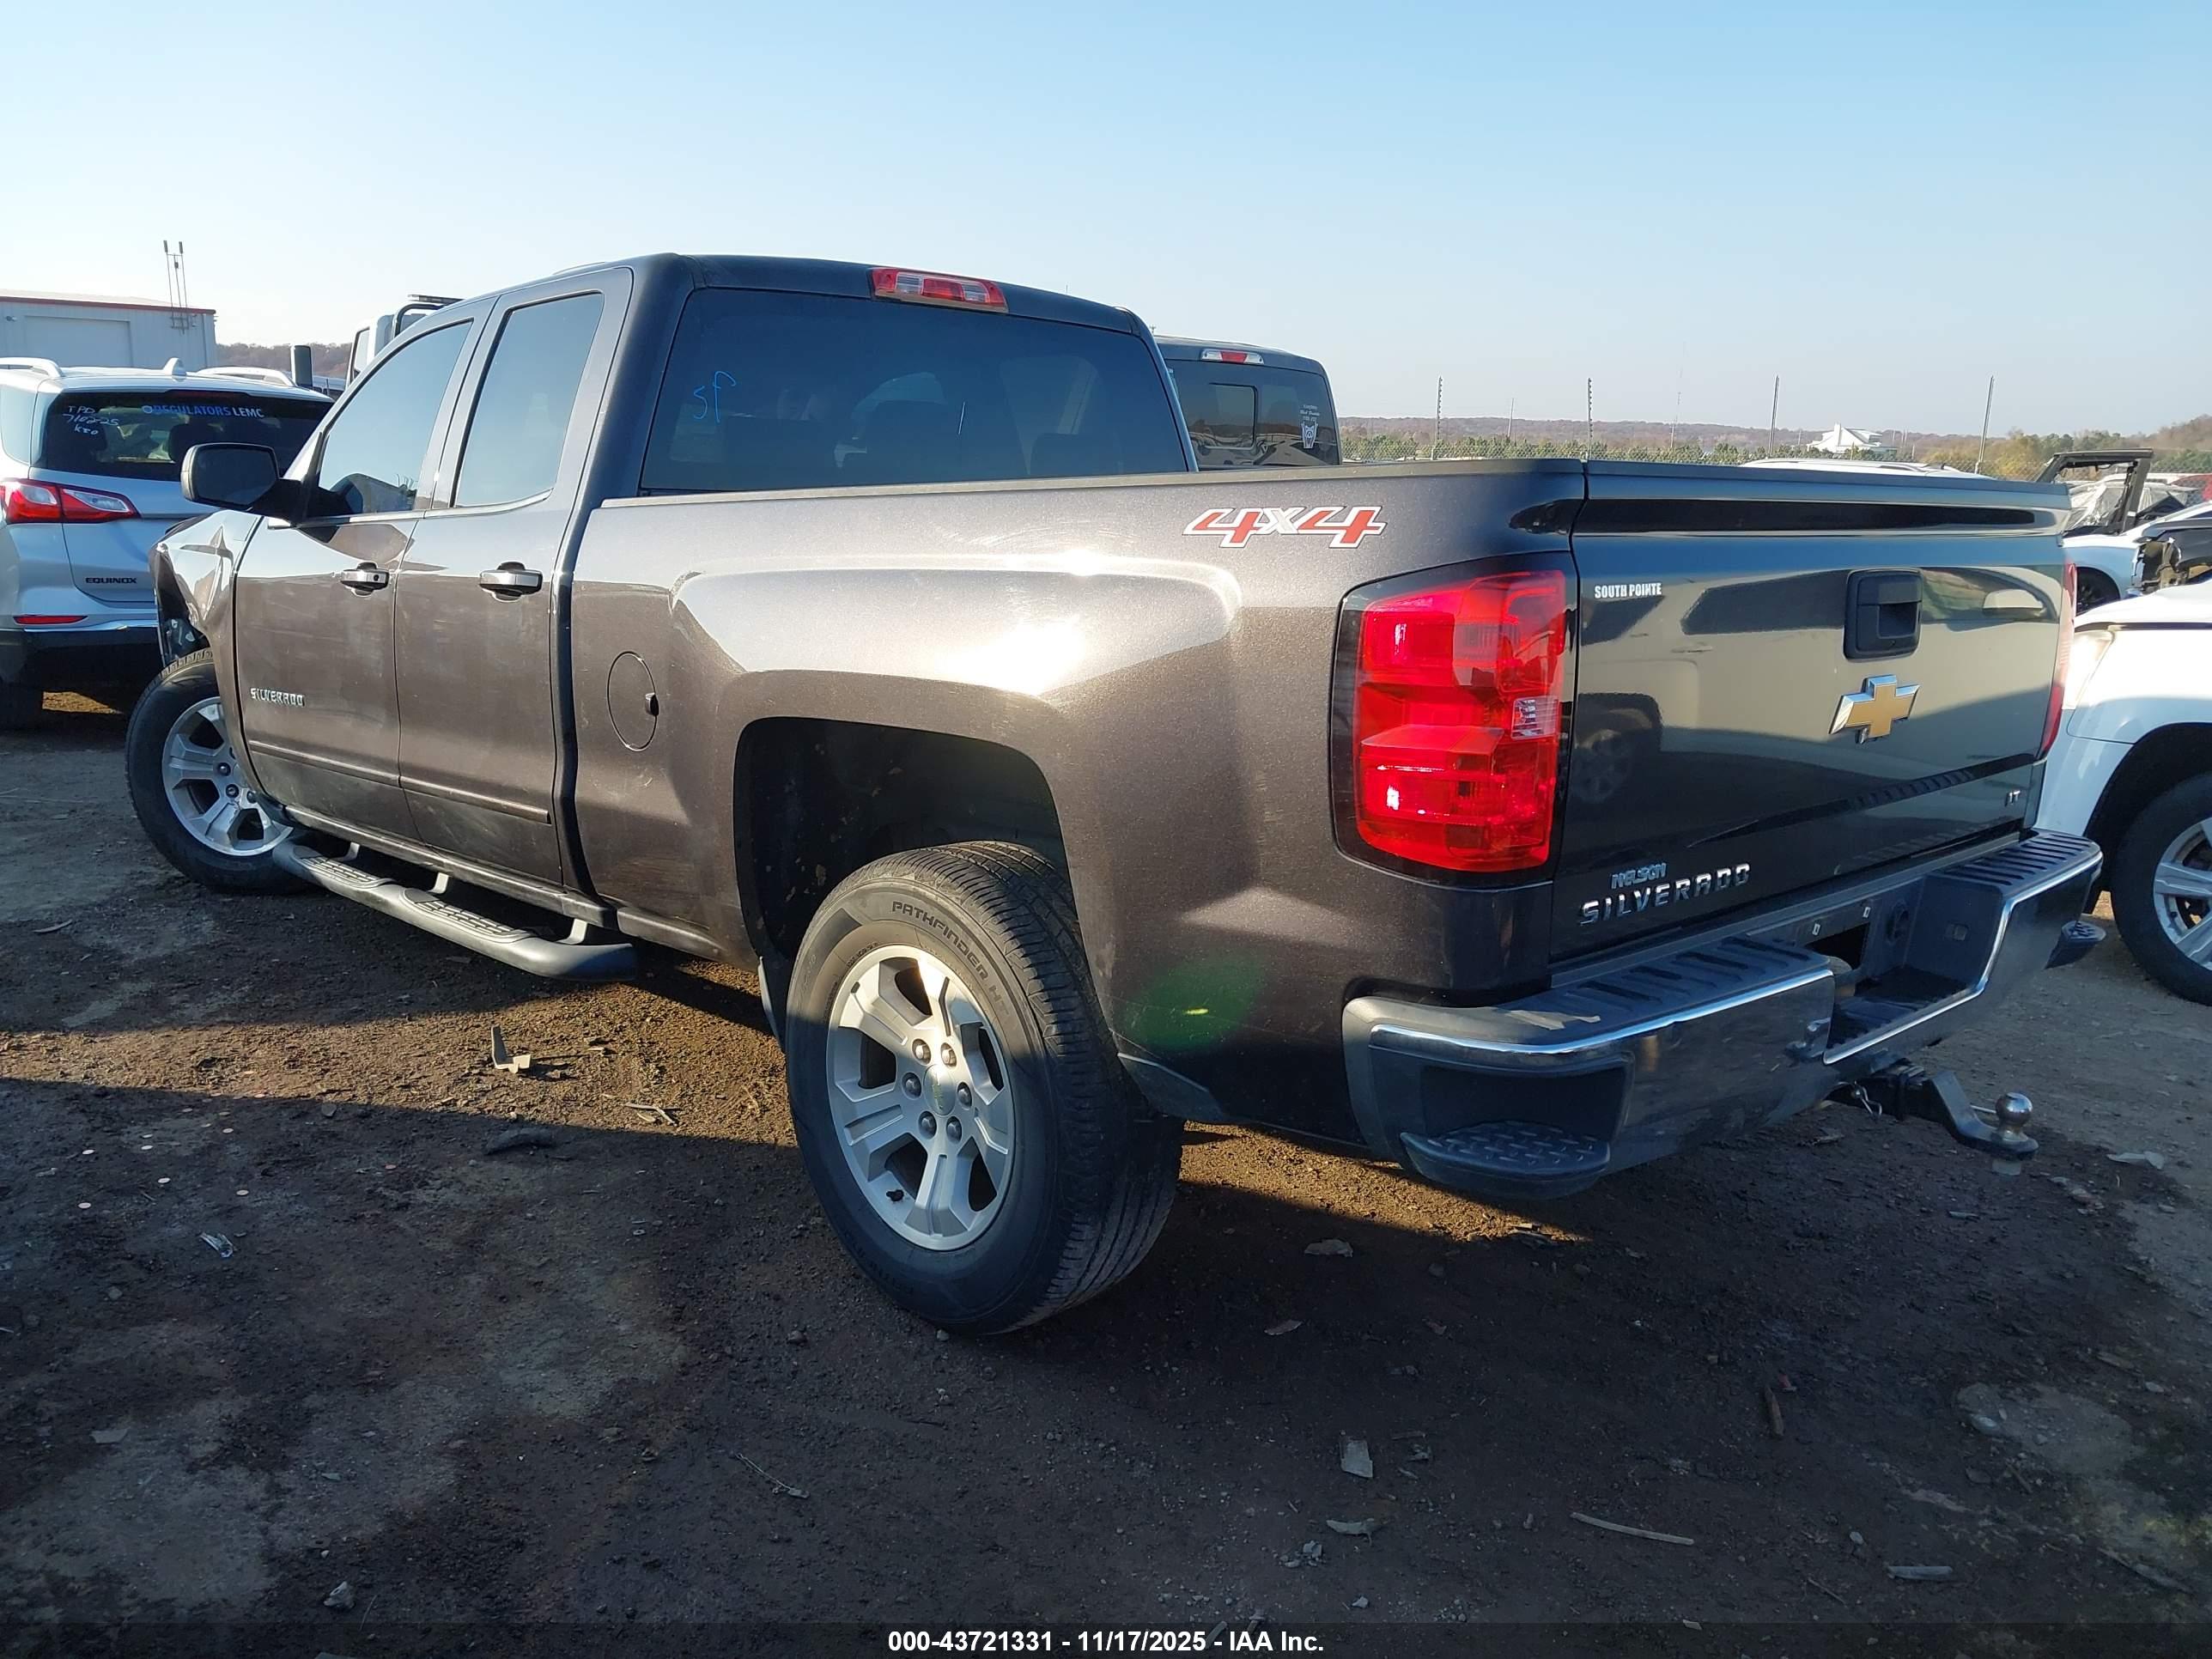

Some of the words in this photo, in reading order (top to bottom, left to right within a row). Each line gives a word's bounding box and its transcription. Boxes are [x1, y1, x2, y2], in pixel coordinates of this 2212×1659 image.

[233, 408, 264, 418] LEMC
[1595, 585, 1627, 599] SOUTH
[1629, 582, 1662, 597] POINTE
[250, 688, 304, 707] SILVERADO
[1611, 862, 1667, 890] NELSON
[1580, 863, 1750, 926] SILVERADO
[892, 901, 989, 981] PATHFINDER
